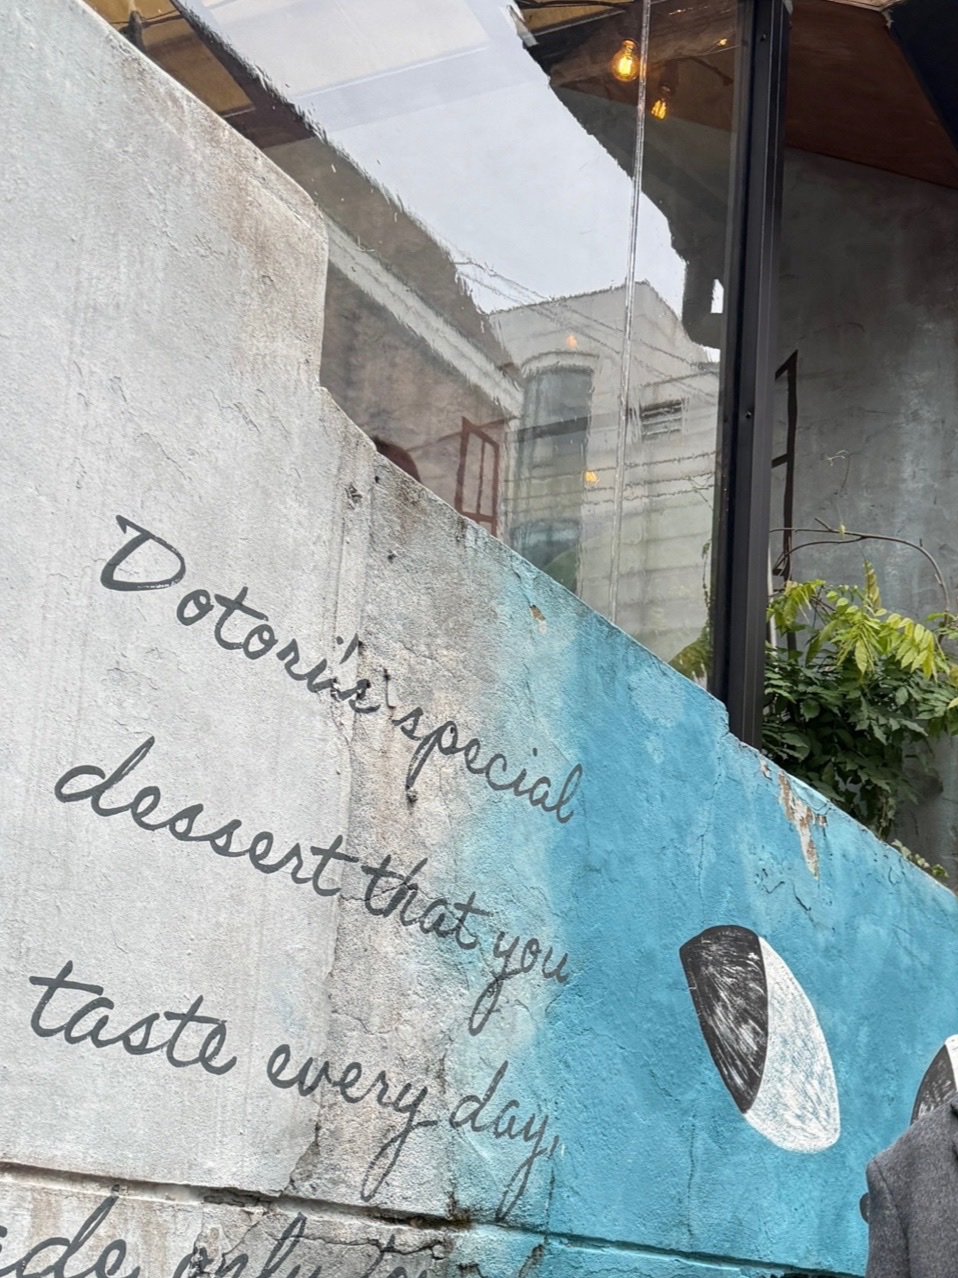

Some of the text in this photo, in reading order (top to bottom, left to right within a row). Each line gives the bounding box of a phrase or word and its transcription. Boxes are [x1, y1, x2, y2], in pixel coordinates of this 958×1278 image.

[100, 514, 583, 824] Dotori's special
[55, 737, 570, 1034] dessert that you
[30, 960, 237, 1075] taste
[267, 1043, 438, 1199] every
